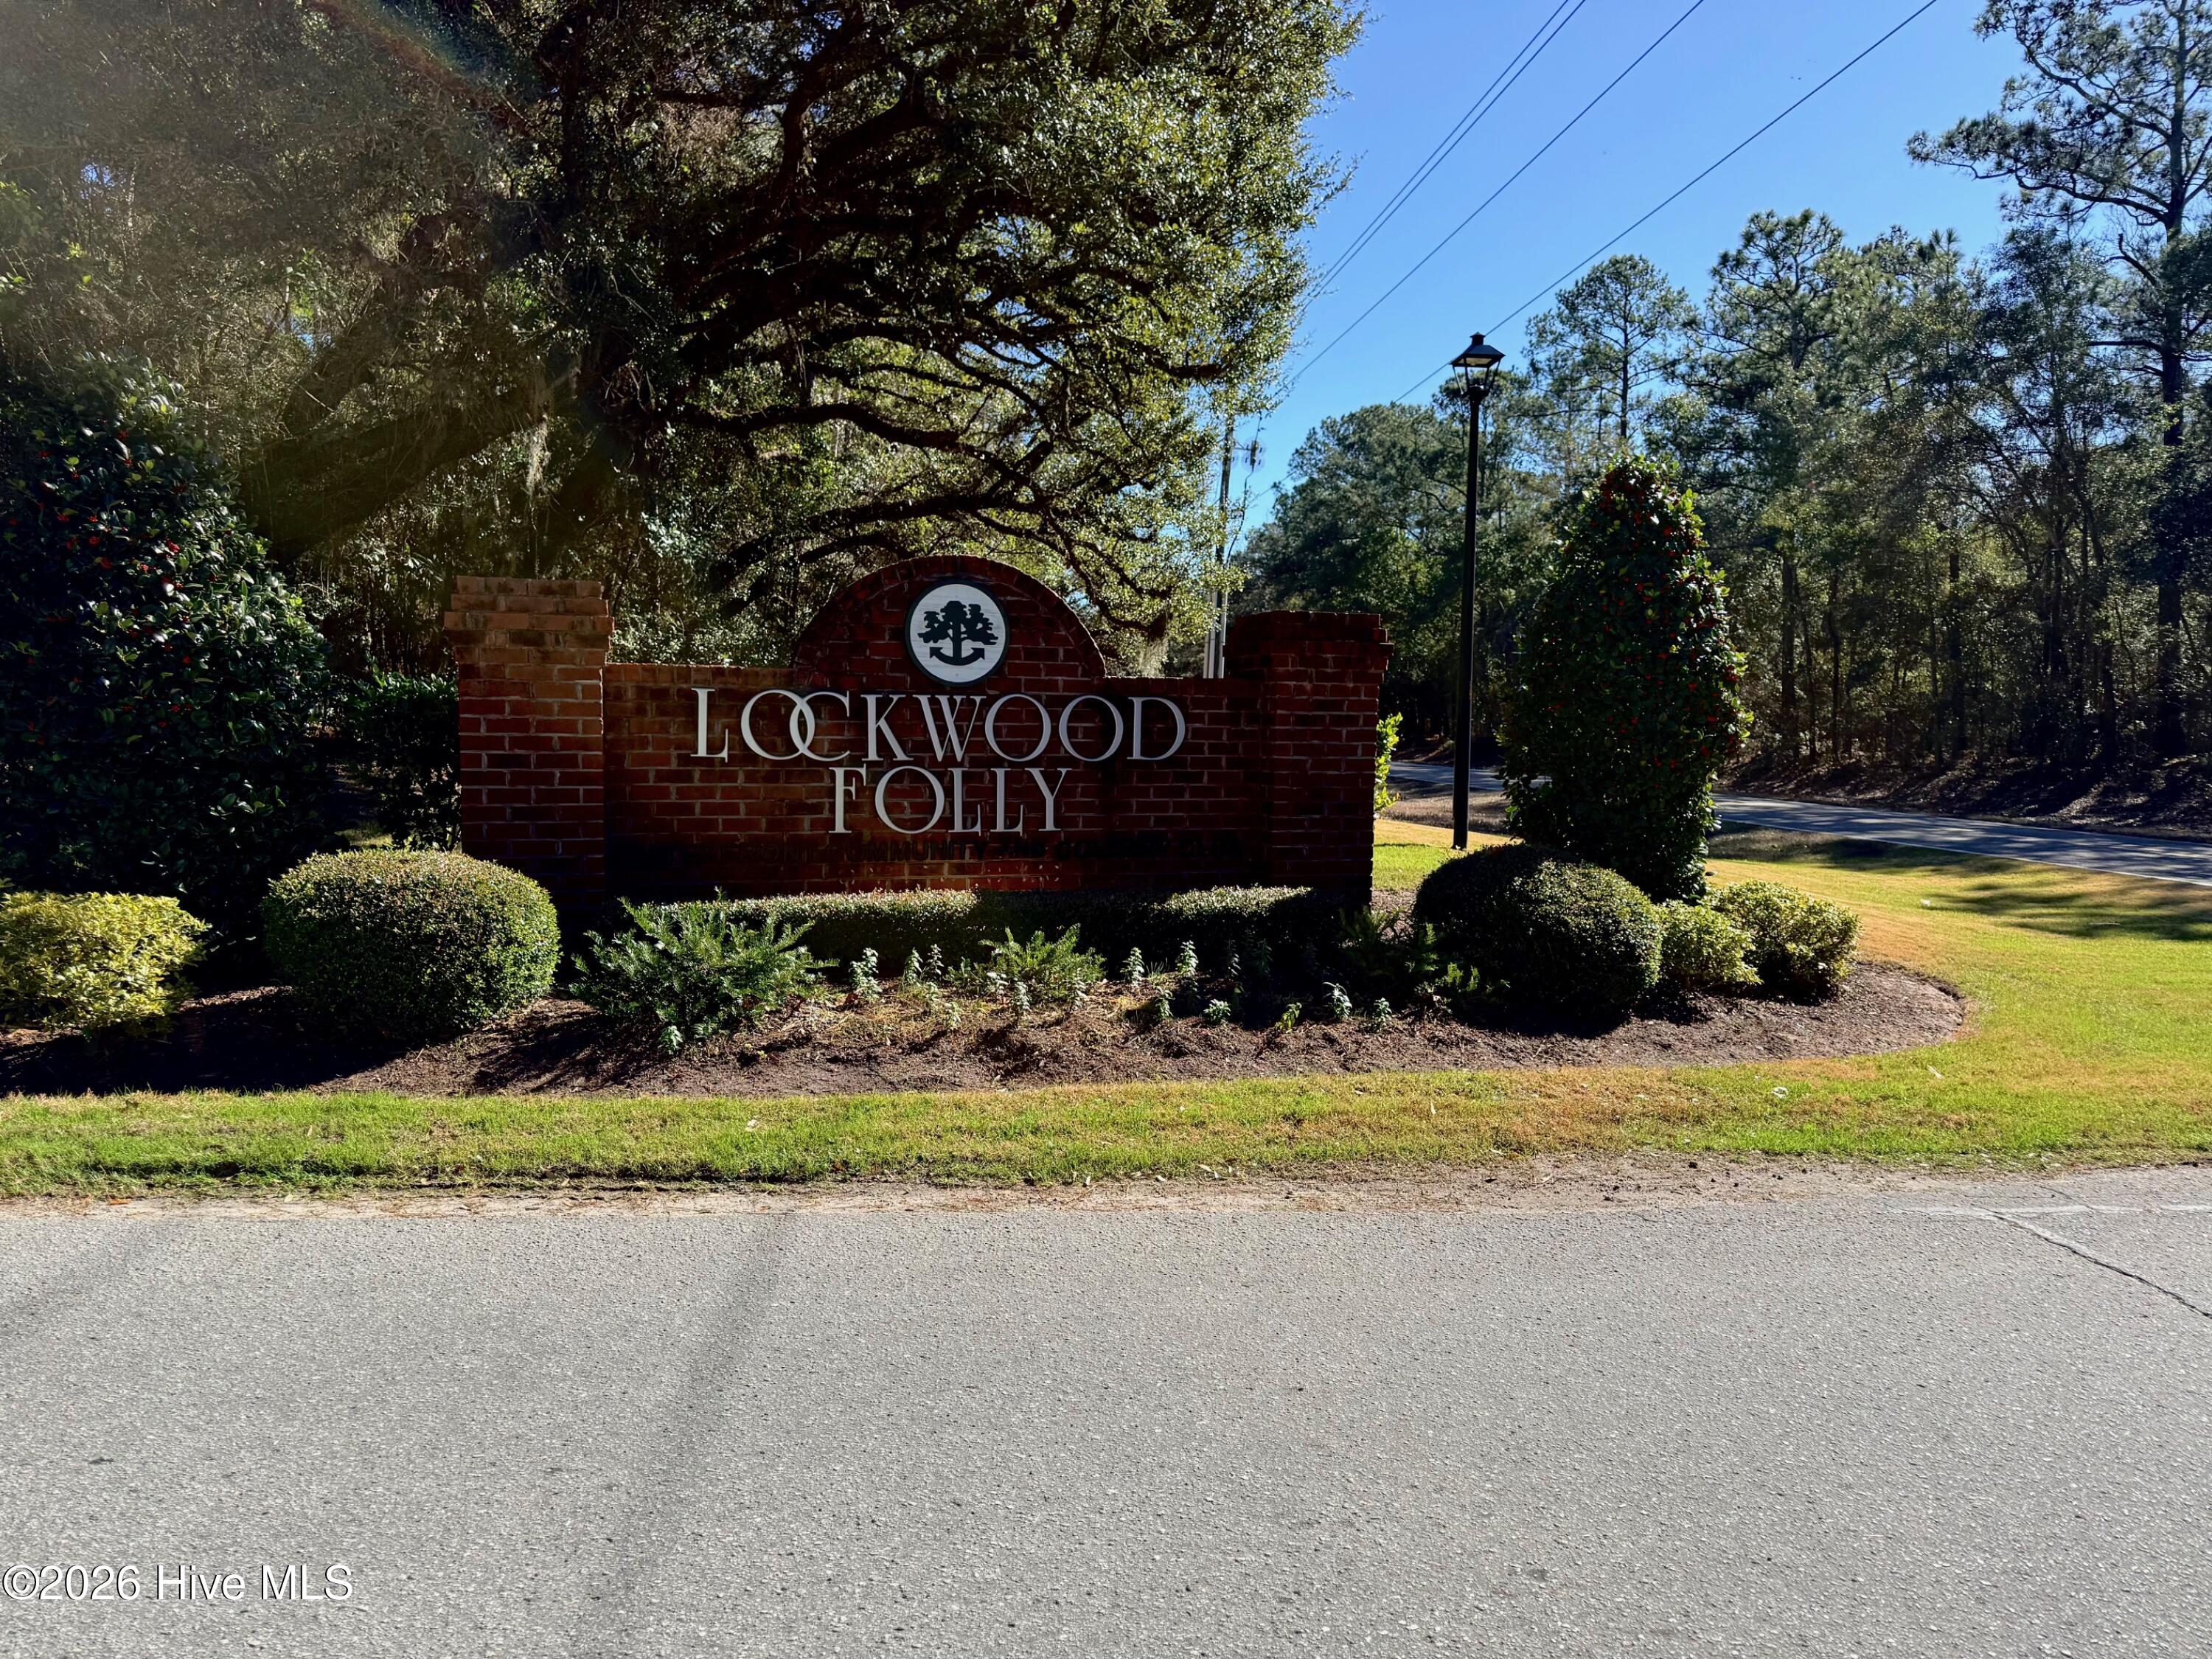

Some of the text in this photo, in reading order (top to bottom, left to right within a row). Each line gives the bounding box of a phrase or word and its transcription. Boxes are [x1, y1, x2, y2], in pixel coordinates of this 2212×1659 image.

[690, 686, 1186, 762] LOCKWOOD
[828, 762, 1073, 836] FOLLY
[826, 838, 989, 864] COMMUNITY
